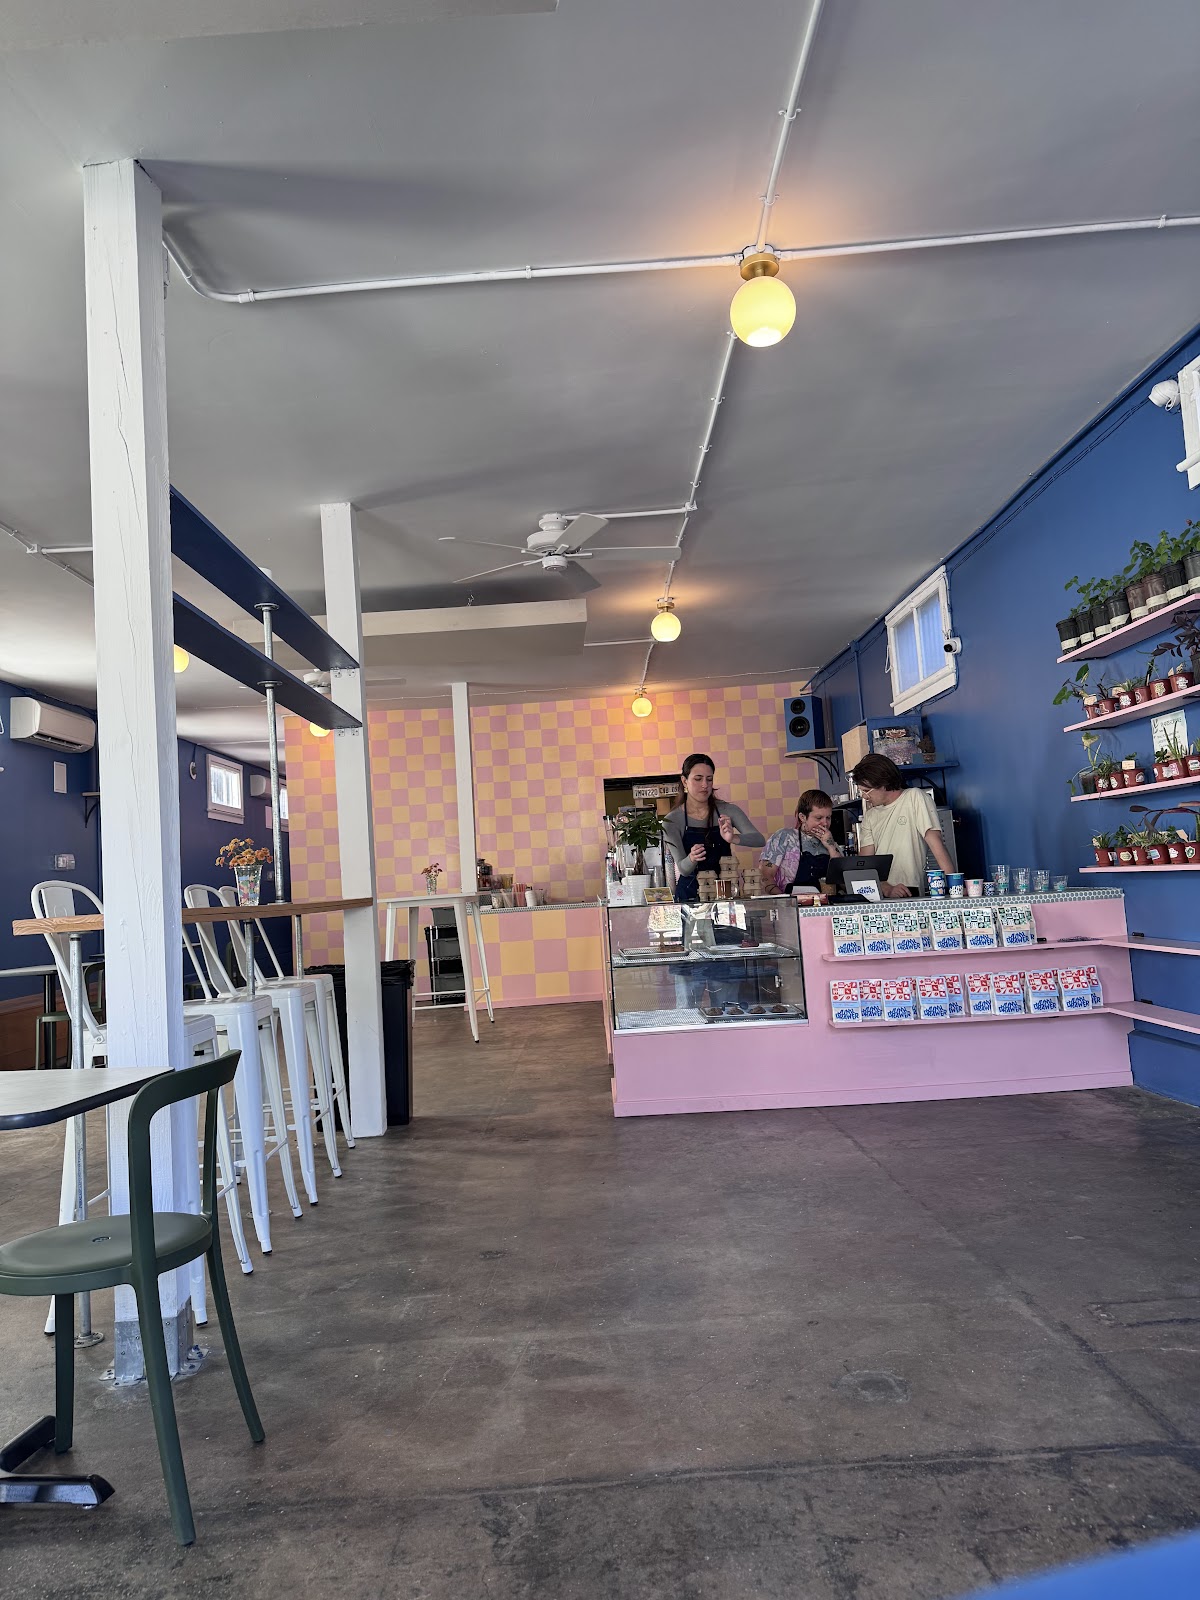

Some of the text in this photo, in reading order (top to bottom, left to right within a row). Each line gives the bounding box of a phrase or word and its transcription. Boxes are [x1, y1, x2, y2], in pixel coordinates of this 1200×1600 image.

[970, 938, 994, 946] DRAWER
[1006, 936, 1029, 944] DRAWER
[838, 945, 861, 954] DRAWER
[867, 944, 891, 952] DRAWER
[1034, 1002, 1056, 1011] DRAWER
[1066, 1000, 1090, 1008] DRAWER
[924, 1009, 947, 1017] DRAWER
[999, 1005, 1021, 1013] DRAWER
[835, 1012, 859, 1020] DRAWER
